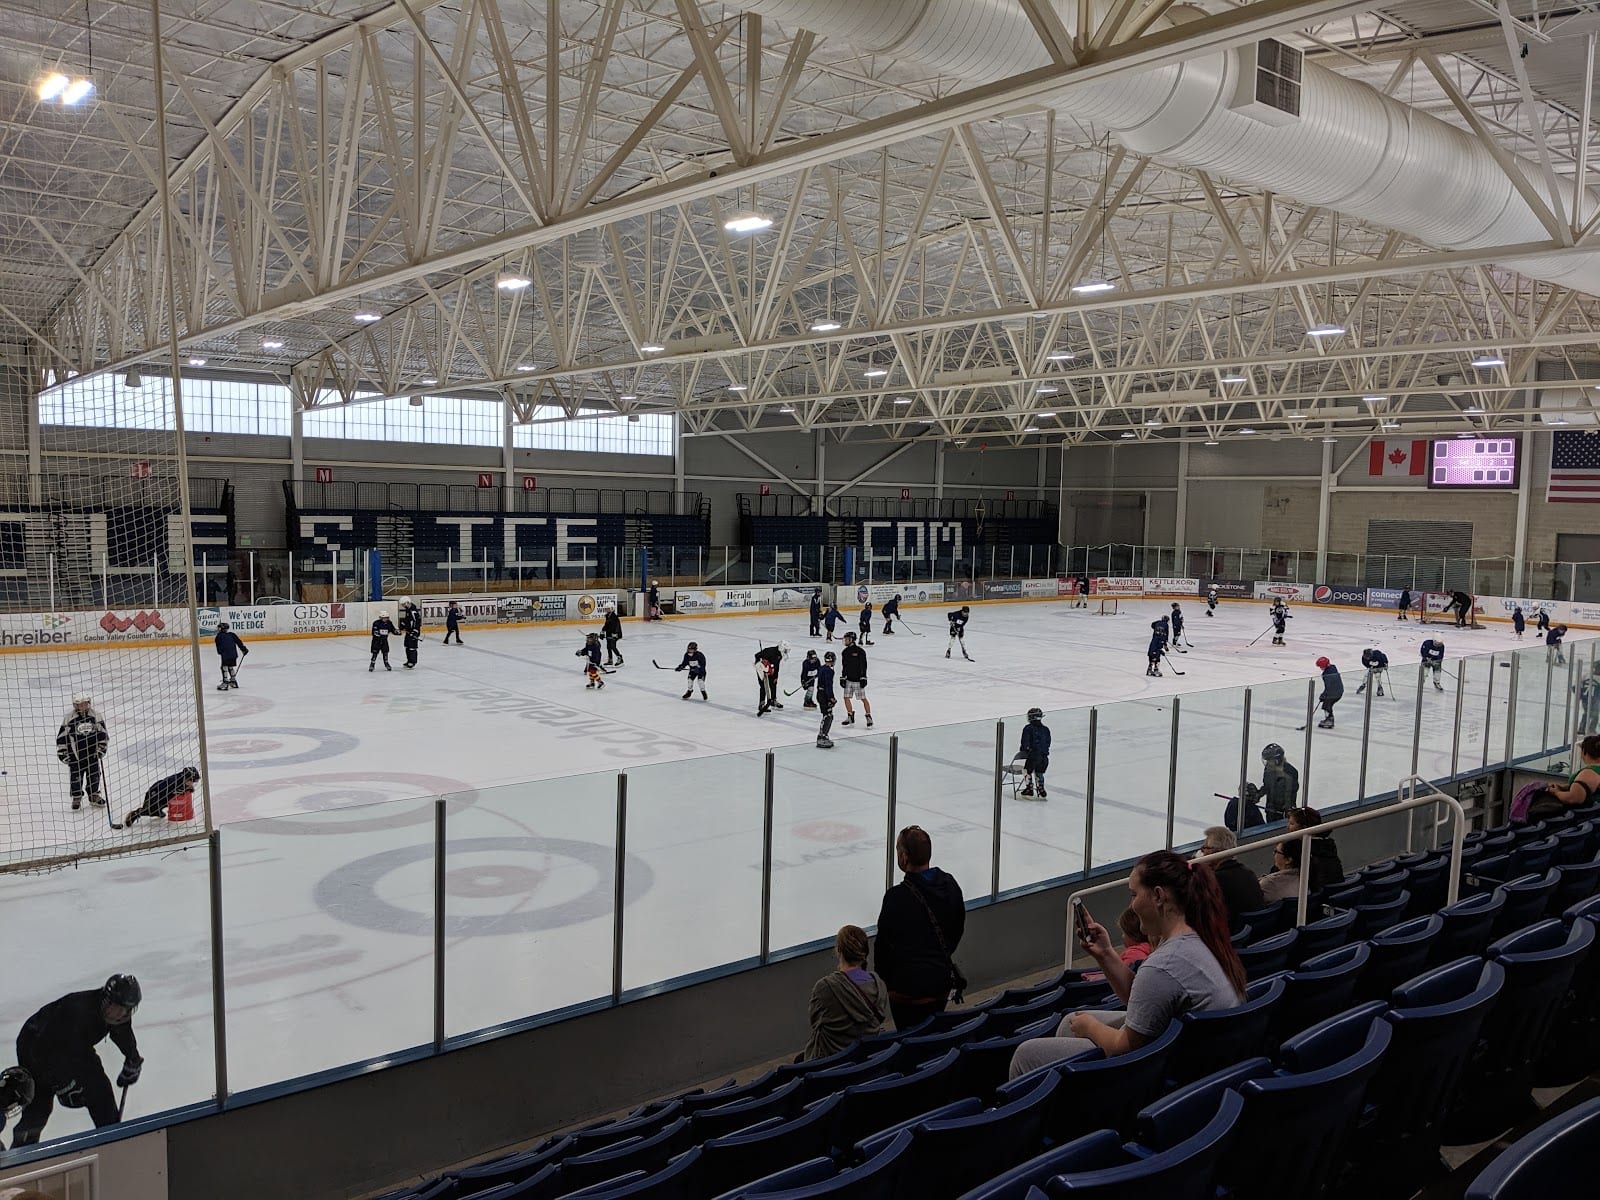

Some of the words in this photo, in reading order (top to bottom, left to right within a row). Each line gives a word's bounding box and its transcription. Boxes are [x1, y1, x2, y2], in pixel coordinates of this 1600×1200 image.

[319, 470, 330, 481] M
[436, 517, 598, 569] ICE
[727, 591, 752, 600] Herald
[1333, 591, 1366, 602] pepsi
[497, 596, 533, 608] SUPERIOR
[742, 598, 770, 607] Journal
[229, 609, 251, 620] We've
[253, 609, 266, 619] Got
[293, 604, 329, 619] GBS
[231, 621, 245, 630] THE
[246, 620, 265, 630] EDGE
[0, 629, 72, 645] hreiber
[106, 633, 125, 641] Valley
[127, 632, 152, 640] Counter
